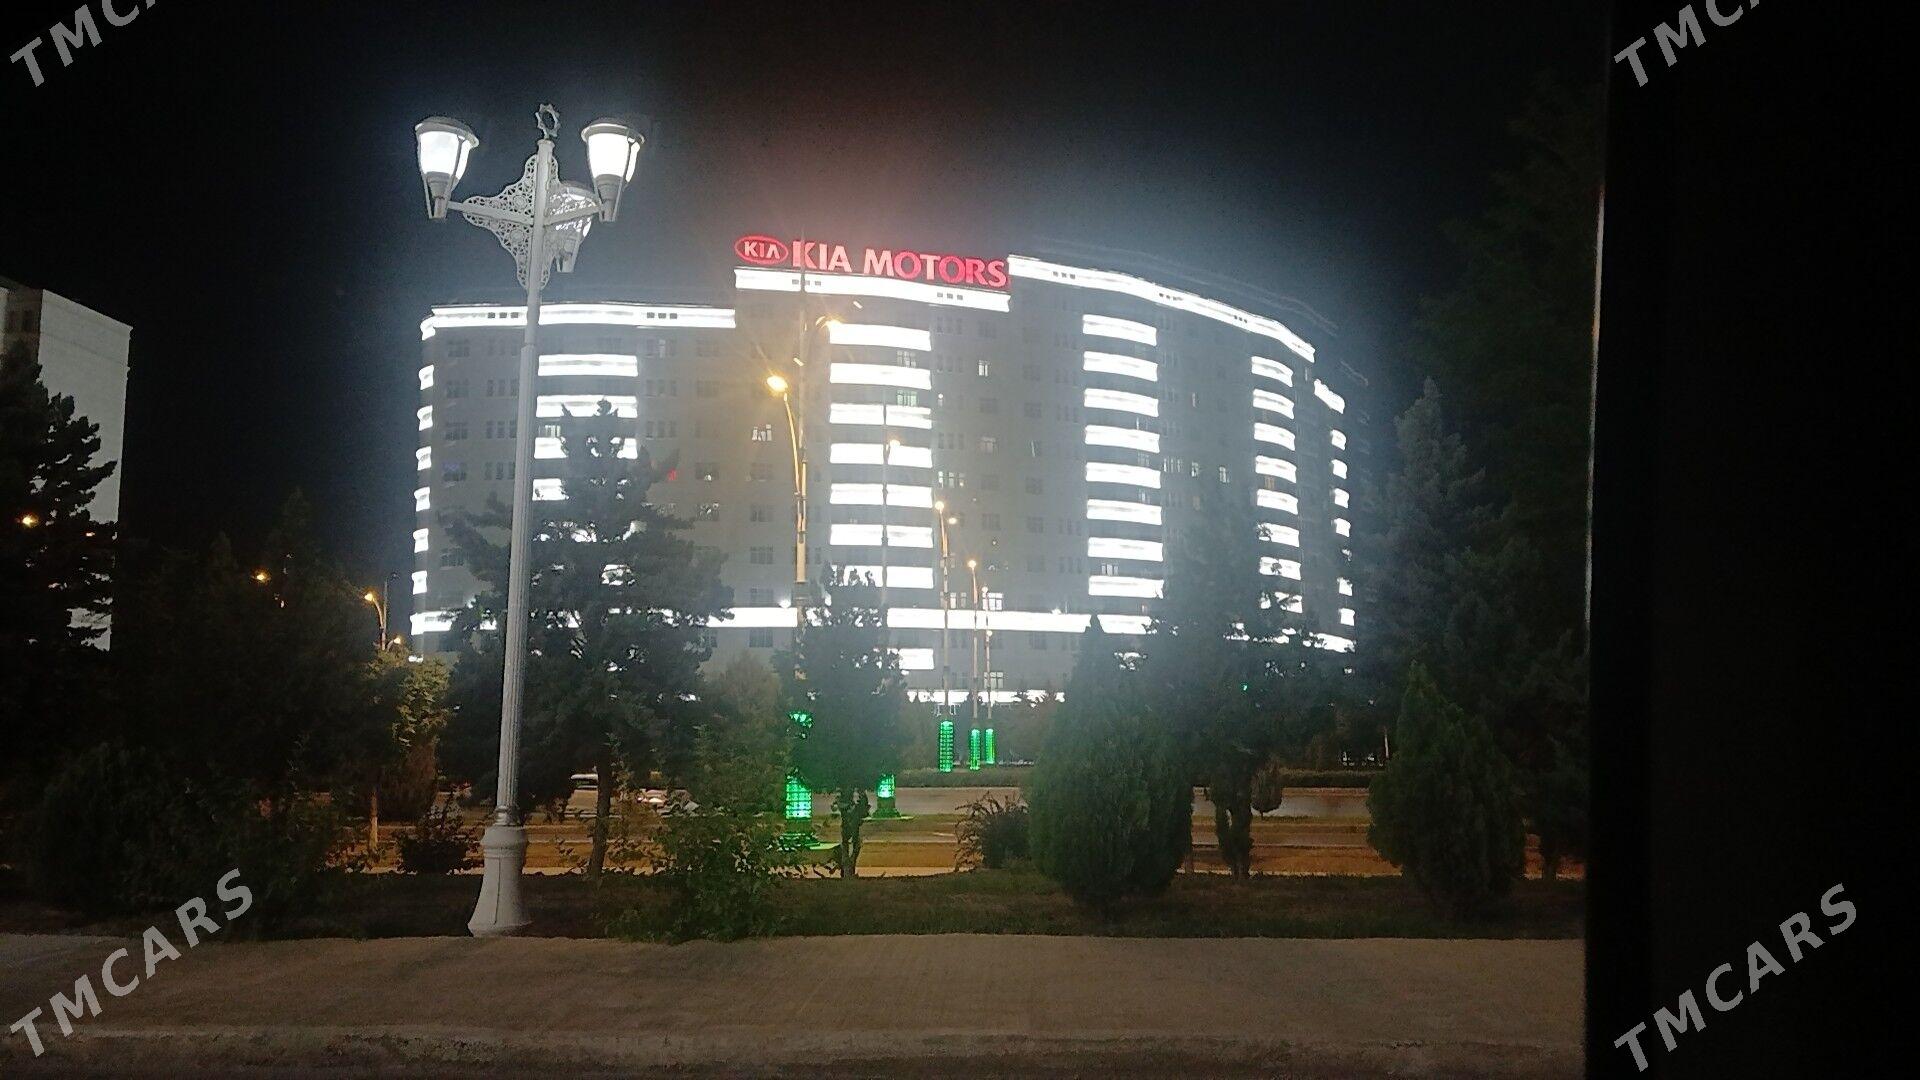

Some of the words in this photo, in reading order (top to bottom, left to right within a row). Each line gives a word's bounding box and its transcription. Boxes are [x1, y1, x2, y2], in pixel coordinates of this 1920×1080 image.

[743, 240, 781, 260] KIA
[791, 239, 853, 273] KIA
[863, 248, 1010, 288] MOTORS
